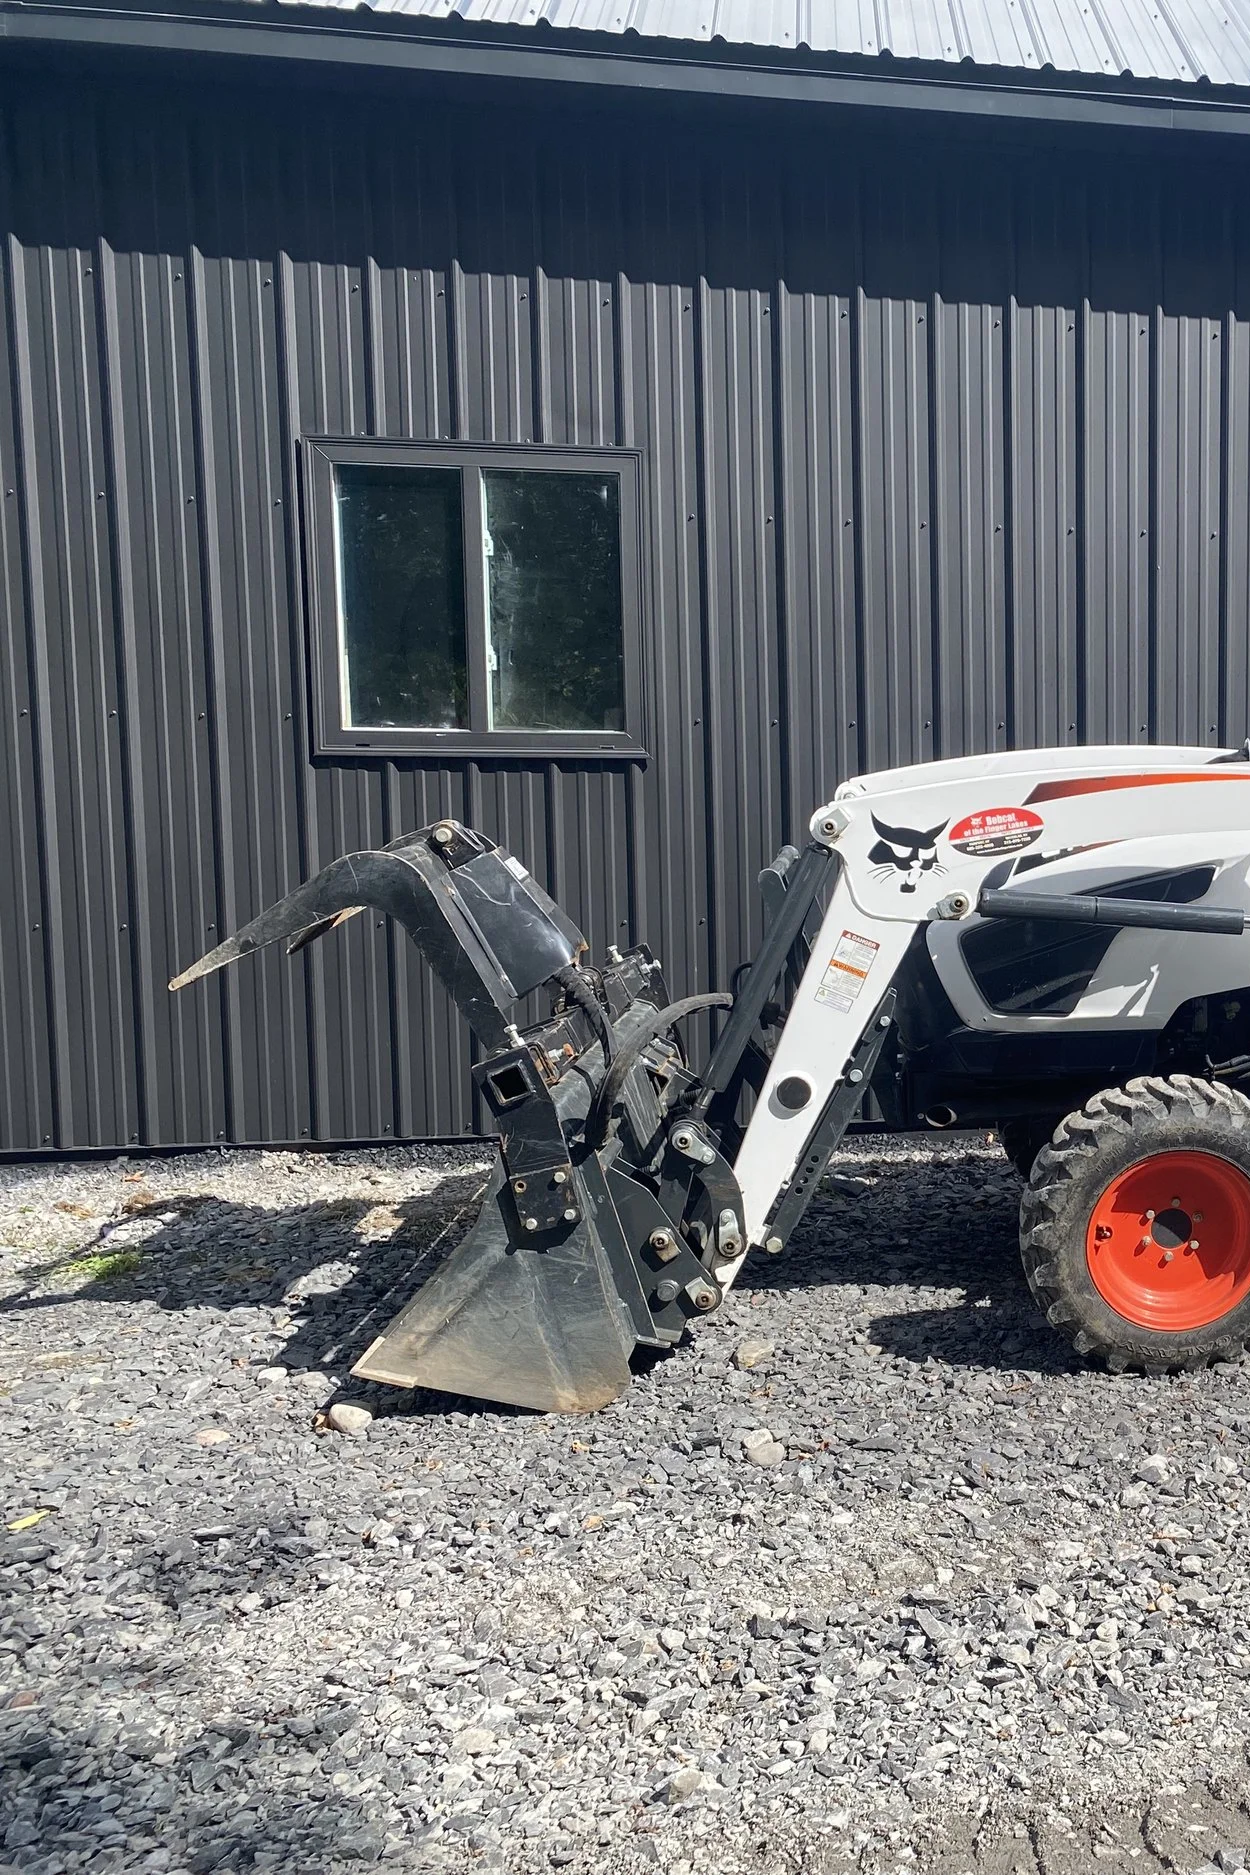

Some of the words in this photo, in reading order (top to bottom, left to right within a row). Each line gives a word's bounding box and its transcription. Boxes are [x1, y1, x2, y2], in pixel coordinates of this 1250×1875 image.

[985, 812, 1016, 826] Bobcat
[963, 829, 972, 837] of
[972, 826, 984, 836] the
[984, 822, 1007, 834] Finger
[1008, 820, 1029, 829] Lakes
[851, 934, 877, 949] DANGER
[839, 963, 864, 976] WARNING
